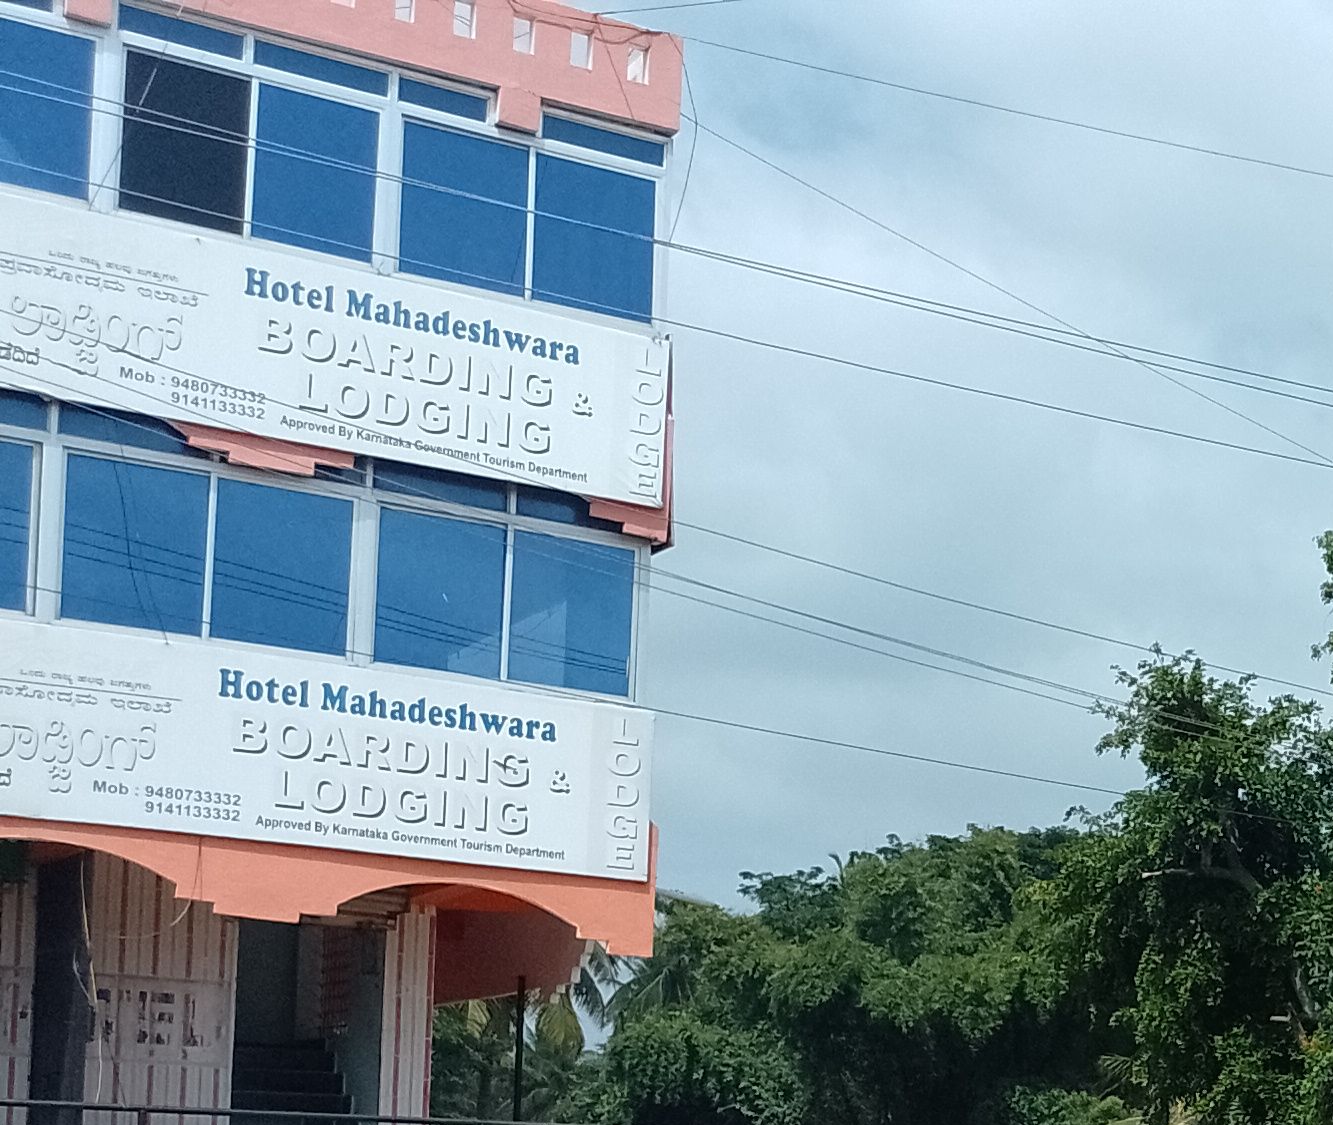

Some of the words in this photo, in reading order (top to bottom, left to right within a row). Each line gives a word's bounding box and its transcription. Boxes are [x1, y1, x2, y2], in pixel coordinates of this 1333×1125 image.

[244, 267, 335, 313] Hotel
[345, 288, 580, 366] Mahadeshwara
[119, 365, 156, 386] Mob
[170, 375, 267, 406] 9480733332
[257, 316, 553, 407] BOARDING
[571, 391, 594, 418] &
[171, 391, 266, 420] 9141133332
[298, 370, 552, 455] LODGING
[628, 346, 665, 499] LODGE
[280, 414, 336, 436] Approved
[338, 426, 353, 441] By
[356, 428, 412, 450] Karnataka
[414, 439, 481, 463] Government
[483, 451, 526, 471] Tourism
[528, 461, 588, 484] Department
[218, 667, 310, 709] Hotel
[320, 682, 558, 743] Mahadeshwara
[233, 716, 530, 788] BOARDING
[549, 768, 572, 795] &
[92, 779, 130, 797] Mob
[144, 784, 243, 808] 9480733332
[145, 800, 242, 823] 9141133332
[274, 769, 529, 837] LODGING
[606, 717, 643, 872] LODGE
[255, 814, 312, 832] Approved
[314, 823, 330, 838] By
[332, 823, 389, 842] Karnataka
[391, 830, 458, 850] Government
[460, 838, 503, 854] Tourism
[505, 843, 566, 862] Department
